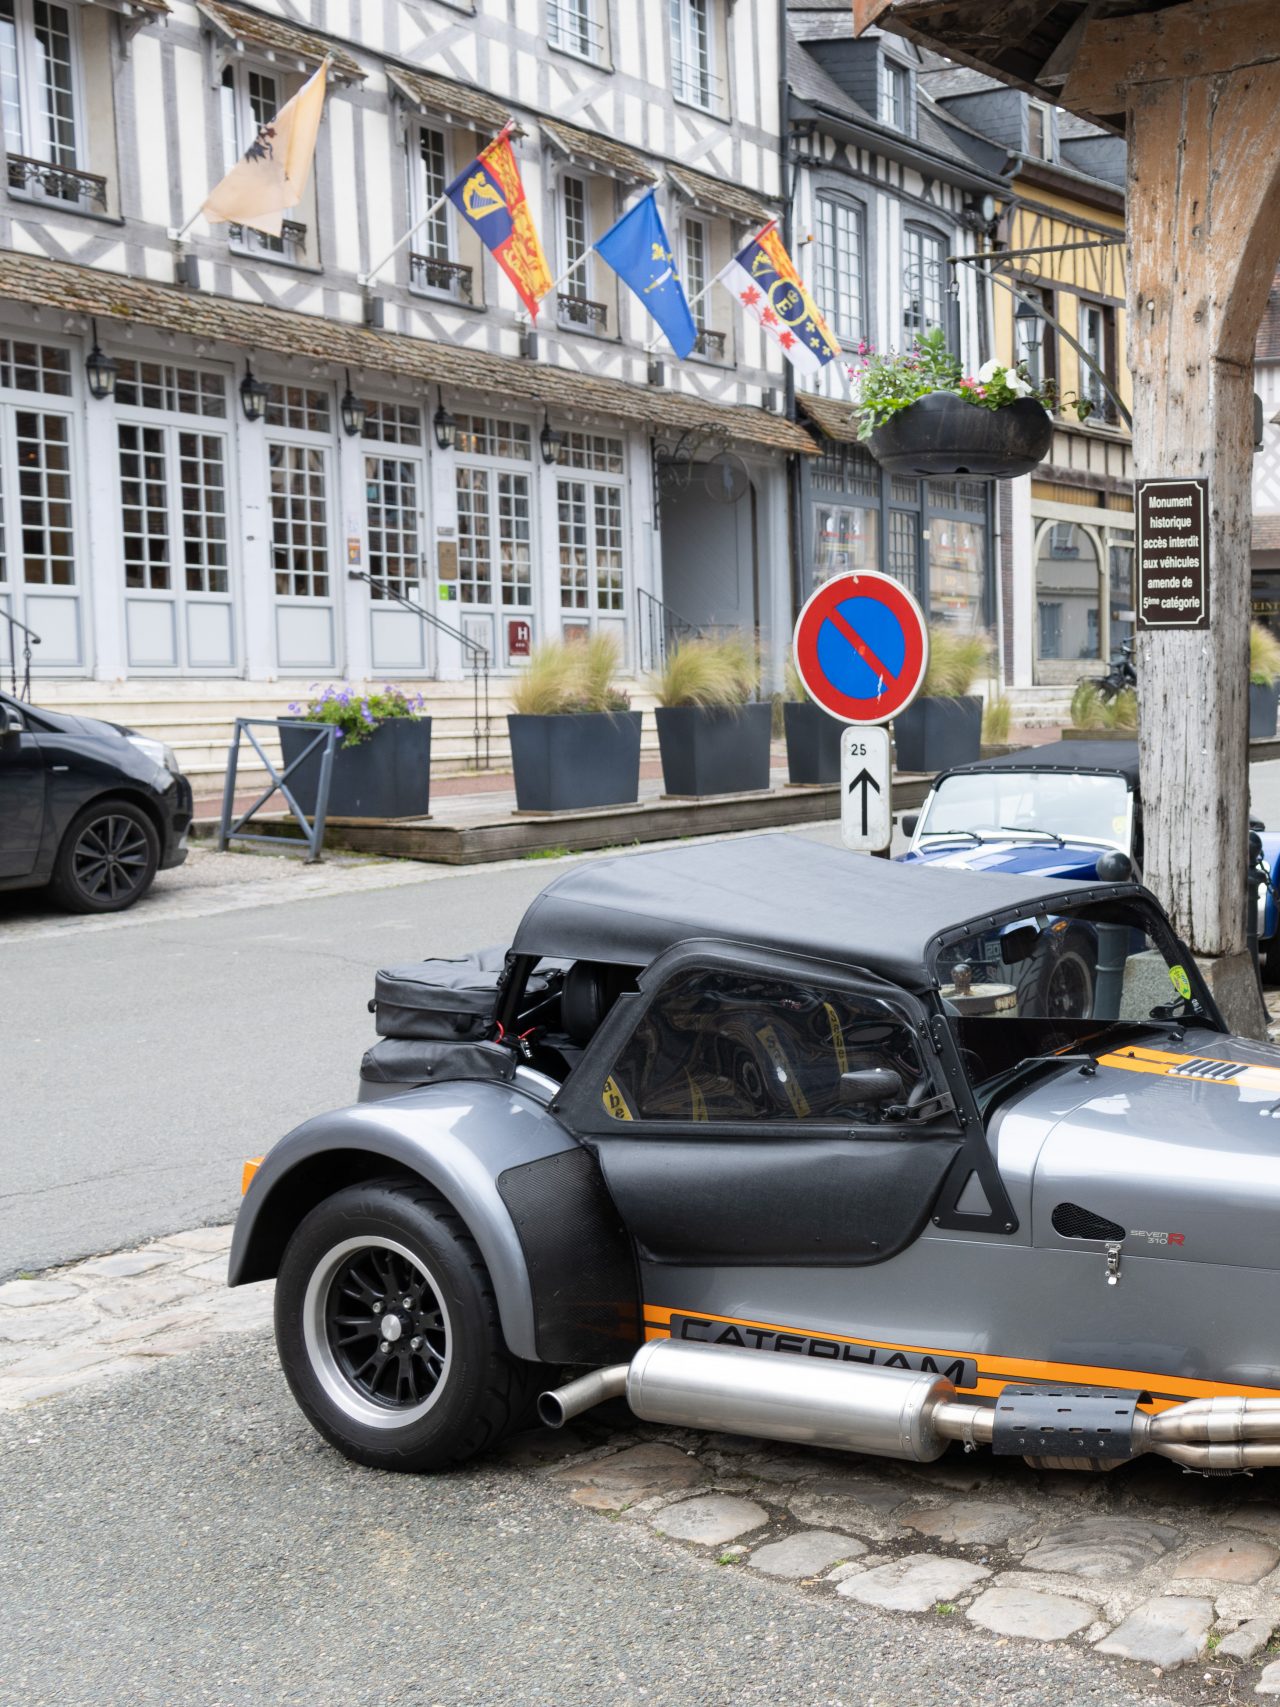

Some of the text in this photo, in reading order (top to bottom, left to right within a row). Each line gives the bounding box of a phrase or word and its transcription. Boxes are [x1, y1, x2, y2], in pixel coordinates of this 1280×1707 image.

[1149, 495, 1192, 508] Monument
[1150, 516, 1192, 530] historique
[1143, 535, 1199, 549] accès interdit
[1143, 556, 1199, 569] aux véhicules
[1147, 576, 1193, 589] amende de
[1161, 595, 1200, 611] catégorie
[517, 626, 528, 640] H
[850, 743, 867, 756] 25
